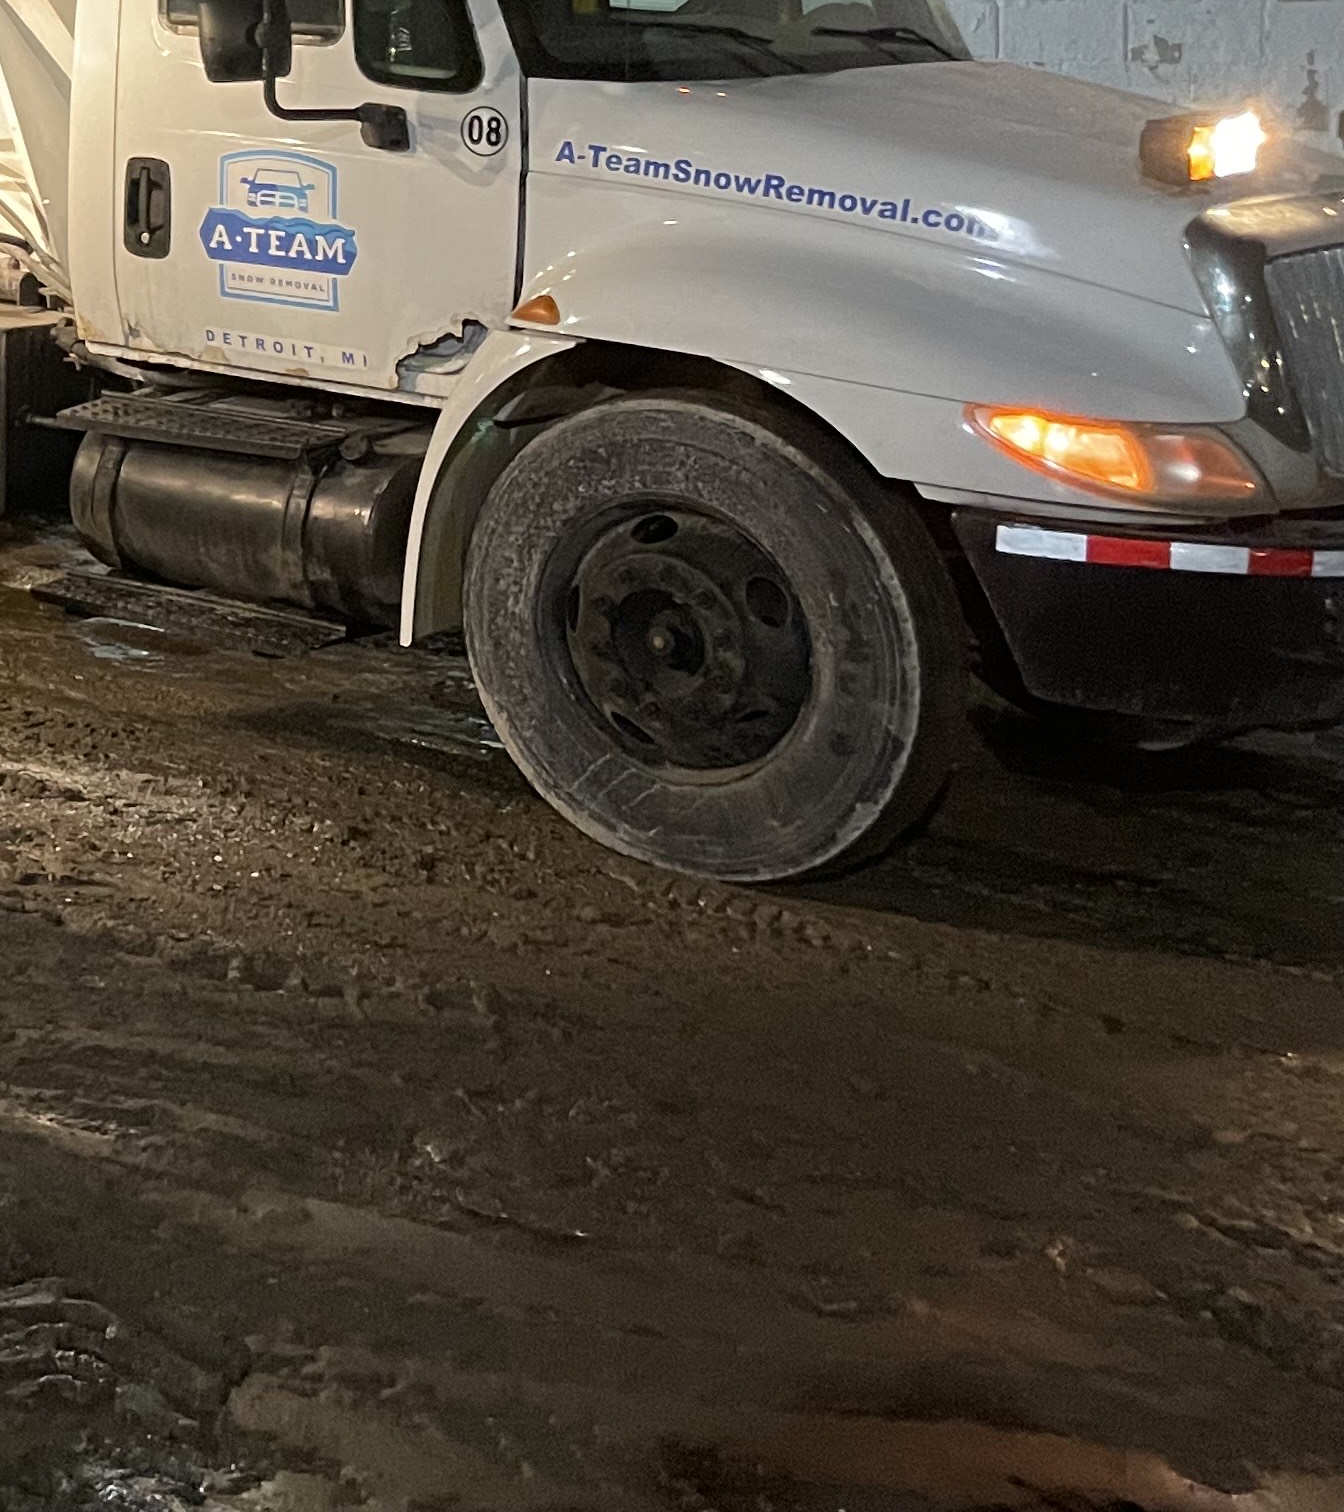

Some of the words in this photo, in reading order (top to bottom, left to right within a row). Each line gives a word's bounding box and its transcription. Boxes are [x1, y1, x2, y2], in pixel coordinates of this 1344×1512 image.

[467, 114, 502, 147] 08
[231, 273, 264, 284] SNOW
[270, 278, 326, 293] REMOVAL
[342, 351, 368, 368] MI
